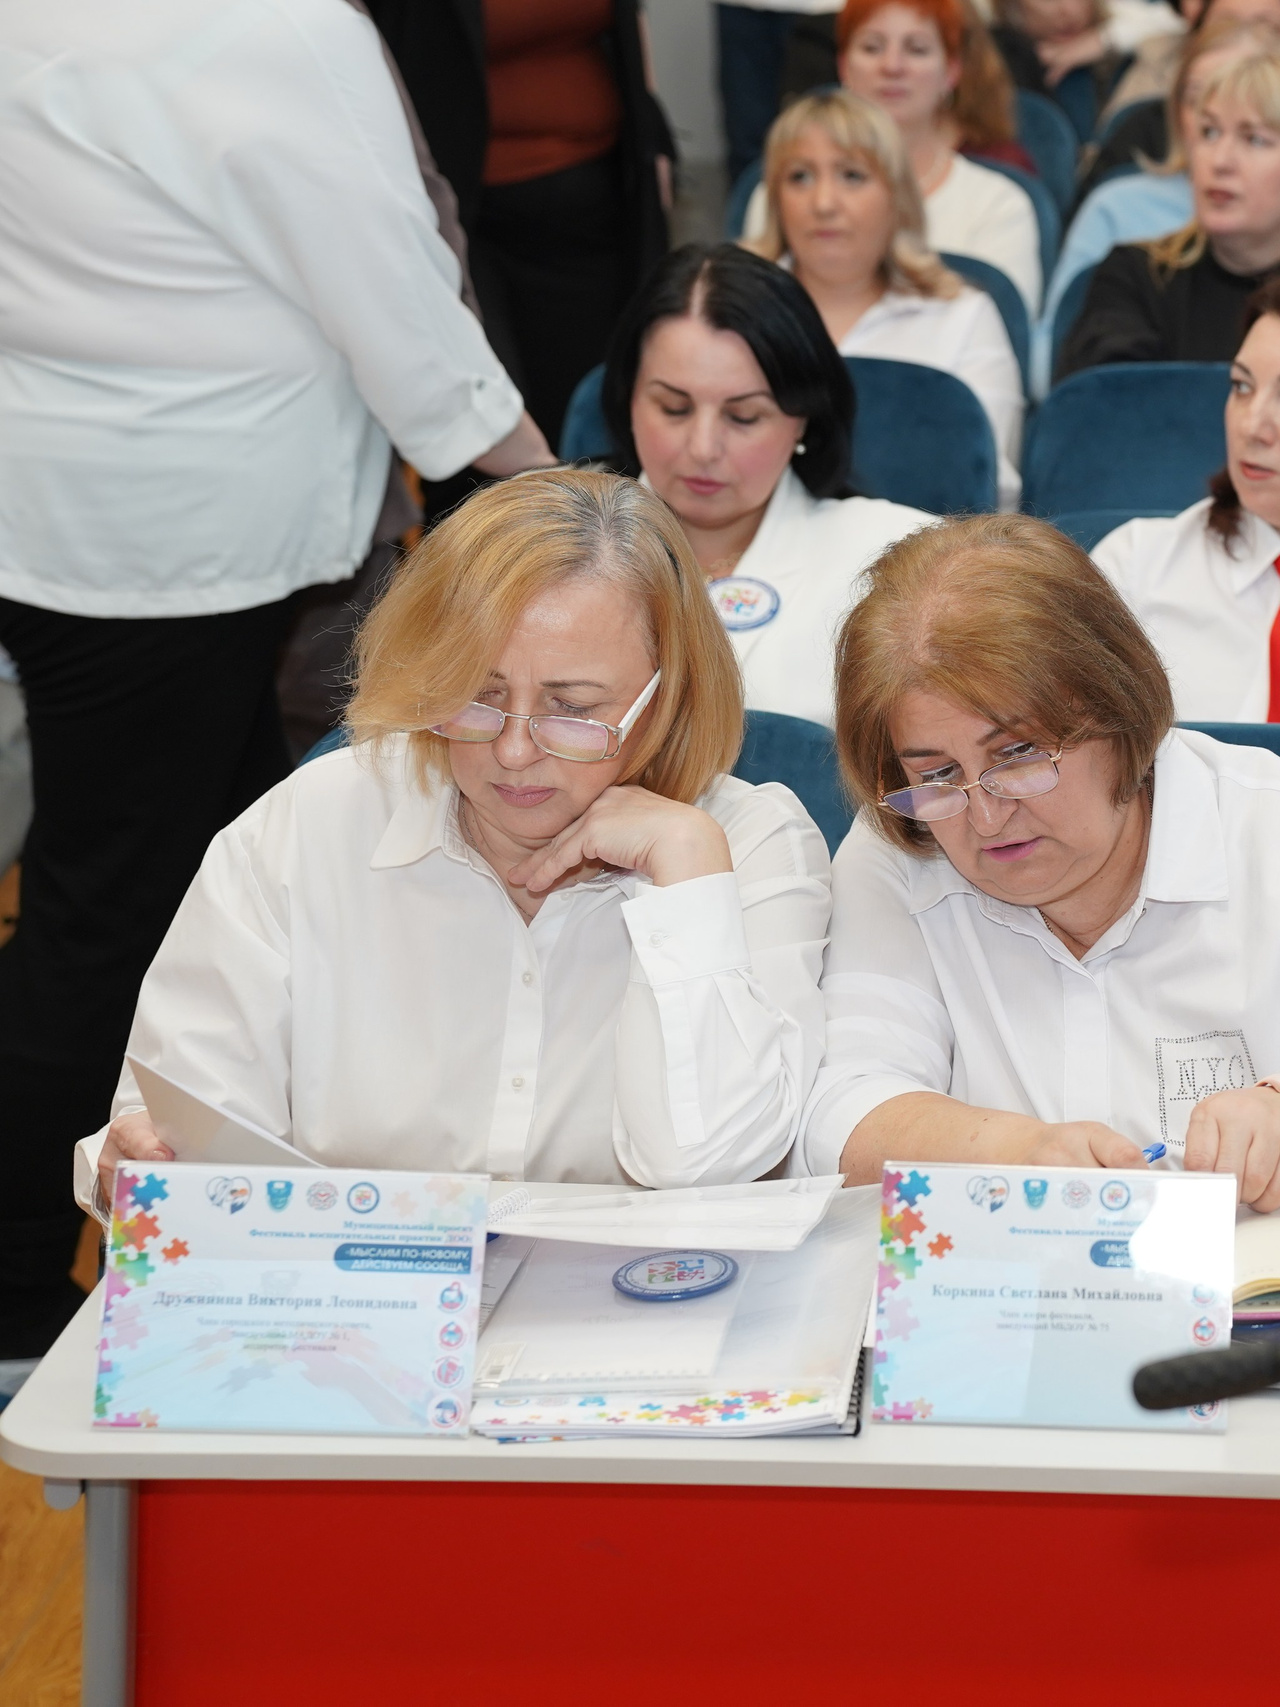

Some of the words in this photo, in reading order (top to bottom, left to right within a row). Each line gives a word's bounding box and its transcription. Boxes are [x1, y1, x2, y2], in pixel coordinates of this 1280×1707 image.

[343, 1220, 434, 1232] Муниципальный
[437, 1223, 473, 1233] проект
[1009, 1226, 1062, 1236] Фестиваль
[249, 1228, 306, 1239] Фестиваль
[351, 1258, 413, 1270] ДЕЙСТВУЕМ
[932, 1284, 995, 1301] Коркина
[999, 1286, 1067, 1300] Светлана
[1072, 1287, 1163, 1302] Михайловна
[153, 1291, 243, 1308] Дружинина
[248, 1293, 322, 1310] Виктория
[326, 1295, 418, 1310] Леонидовна
